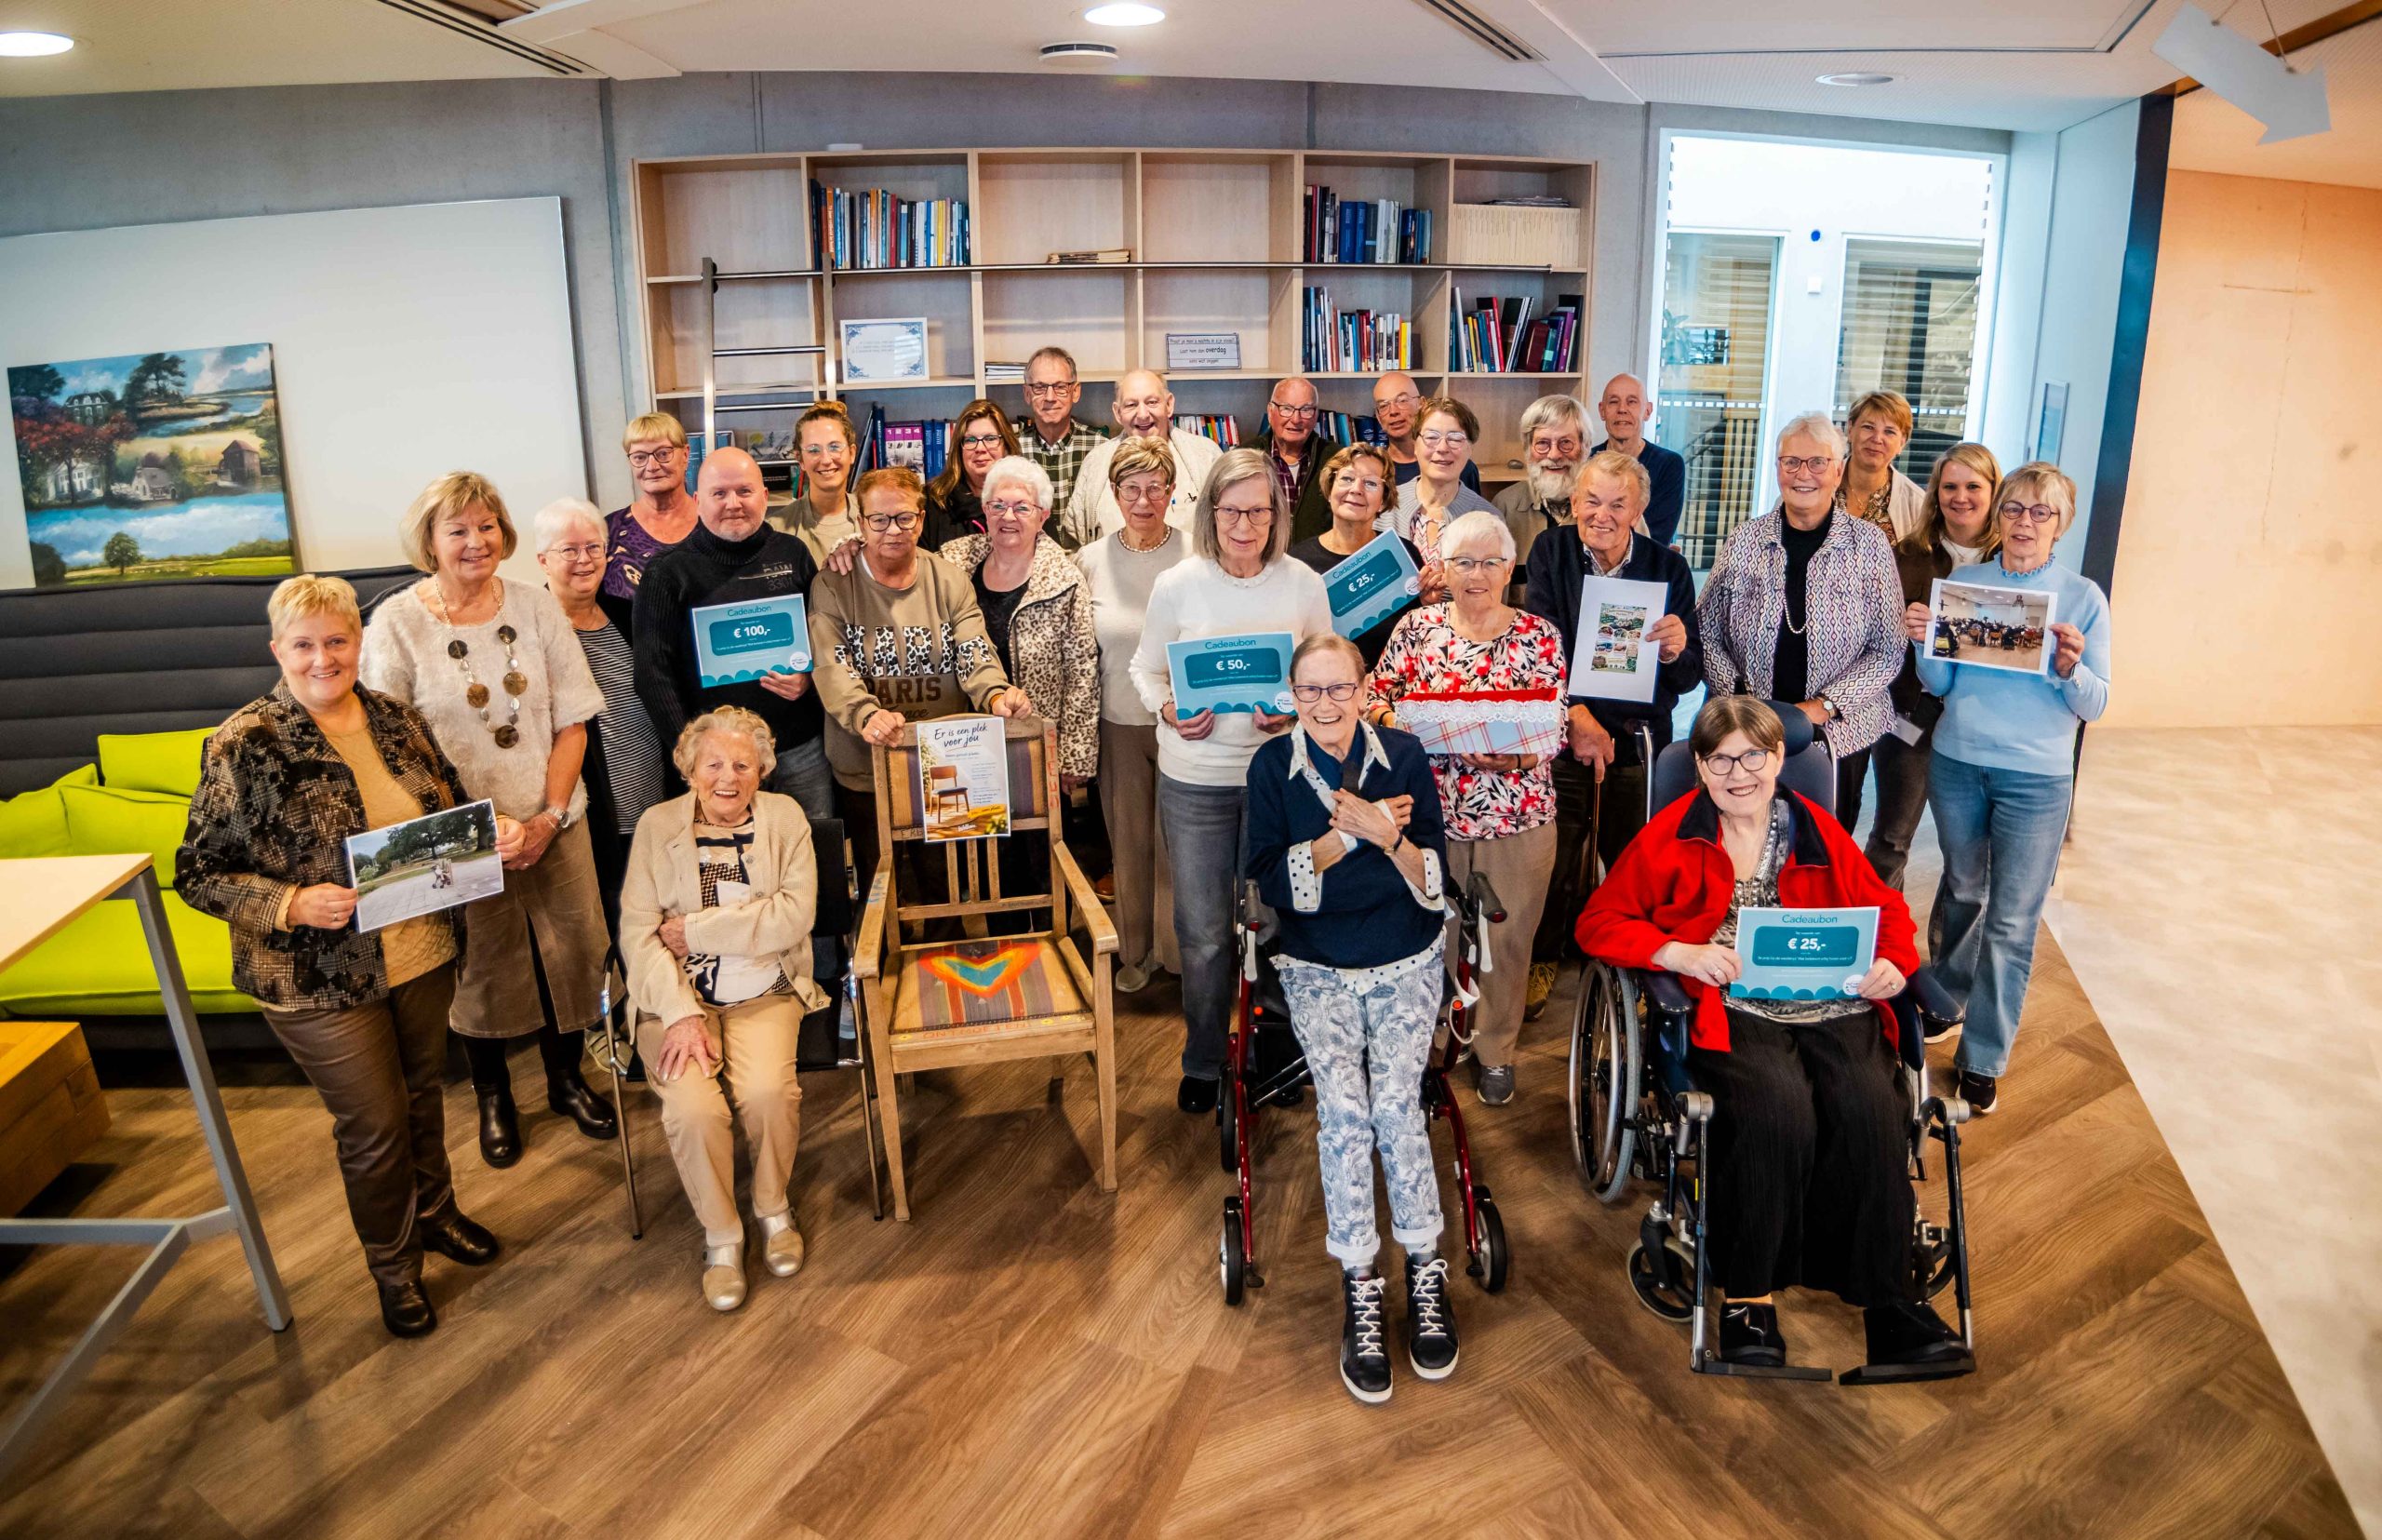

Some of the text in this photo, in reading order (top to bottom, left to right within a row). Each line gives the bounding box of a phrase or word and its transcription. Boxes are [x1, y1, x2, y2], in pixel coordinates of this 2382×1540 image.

[1206, 346, 1226, 355] overdag
[1332, 551, 1372, 579] Cadeaubon
[1348, 583, 1357, 592] €
[1357, 573, 1375, 588] 25,-
[728, 605, 772, 617] Cadeaubon
[733, 625, 770, 638] € 100,-
[1205, 638, 1256, 649] Cadeaubon
[1215, 659, 1251, 671] € 50,-
[864, 676, 942, 704] PARIS
[934, 728, 945, 741] Er
[949, 729, 955, 737] is
[971, 722, 988, 737] plek
[943, 735, 979, 748] voor jou
[1782, 914, 1838, 924] Cadeaubon
[1787, 938, 1827, 951] € 25,-
